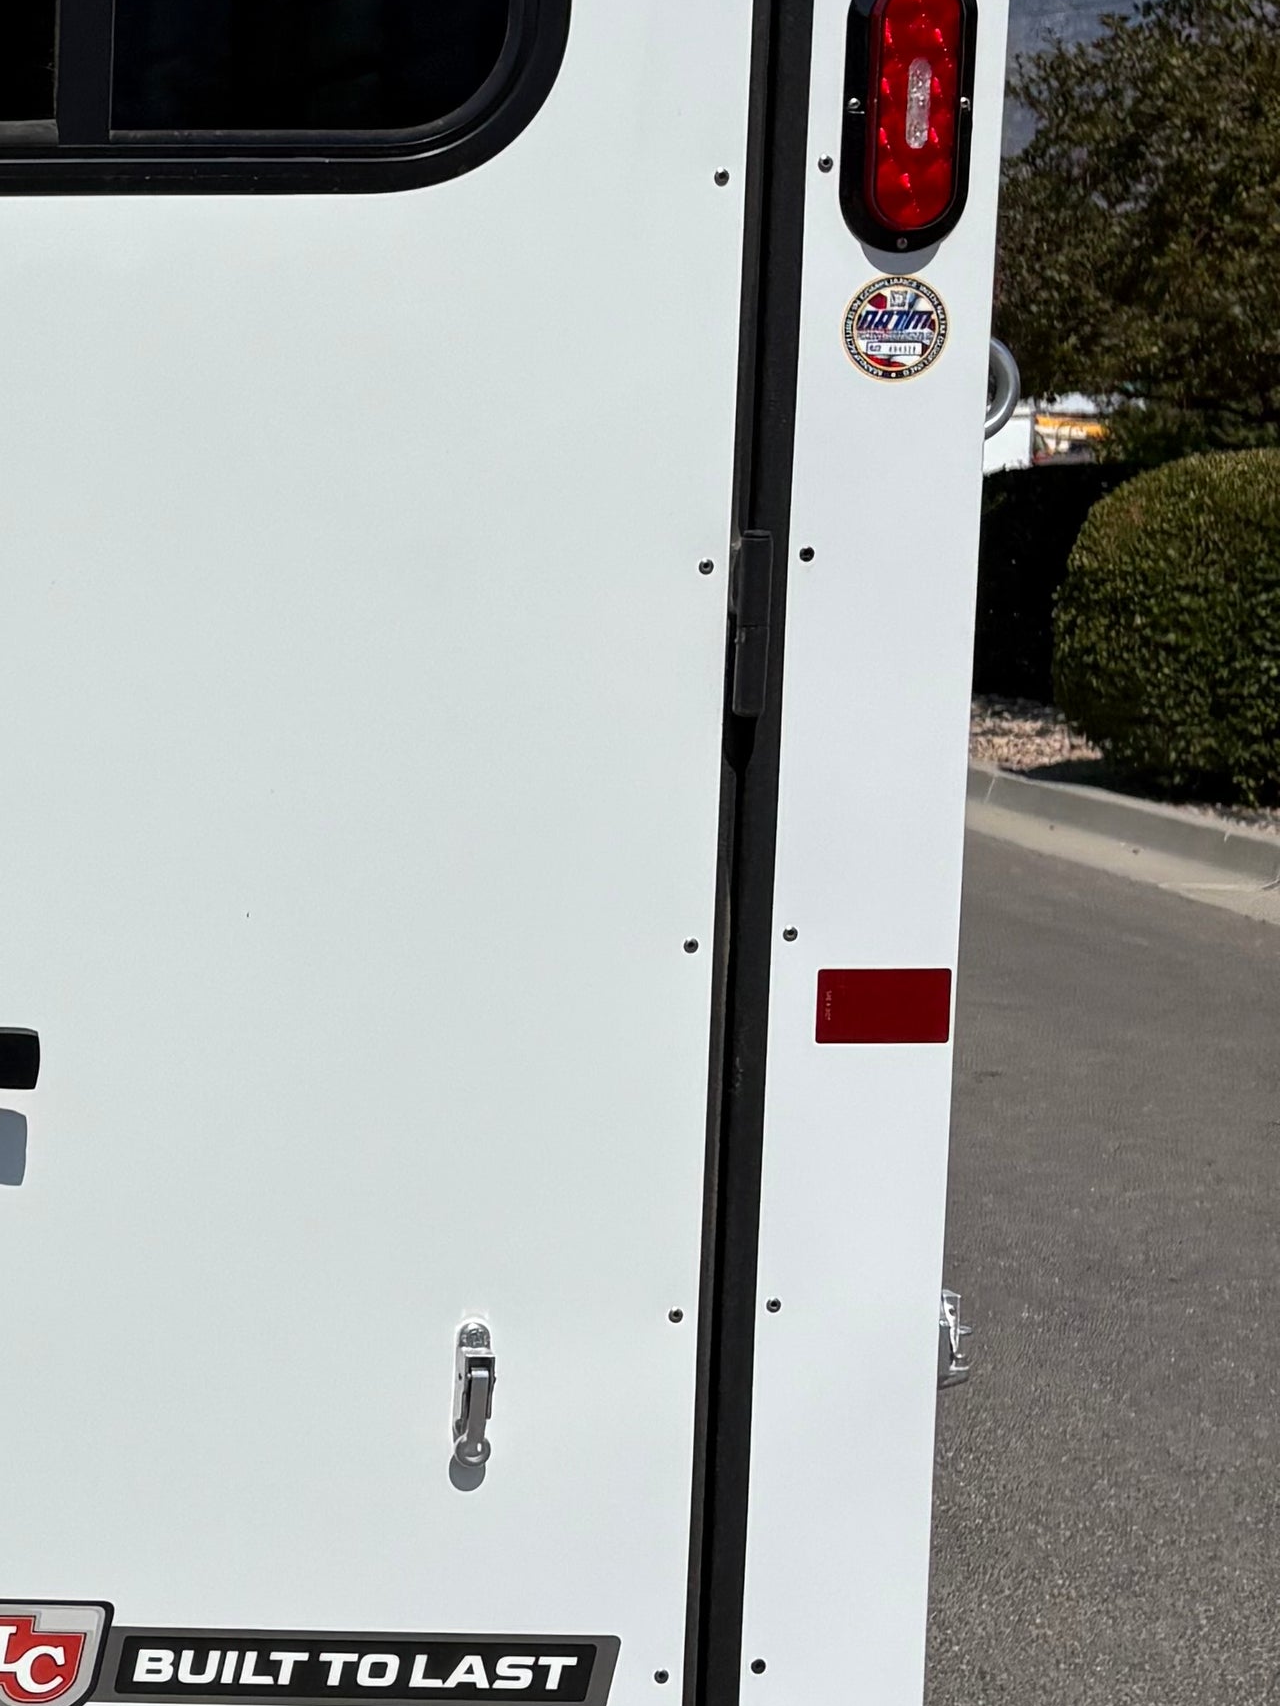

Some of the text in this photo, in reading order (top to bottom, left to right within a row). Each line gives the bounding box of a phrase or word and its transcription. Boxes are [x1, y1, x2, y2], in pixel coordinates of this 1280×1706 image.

[131, 1647, 579, 1691] BUILT TO LAST
